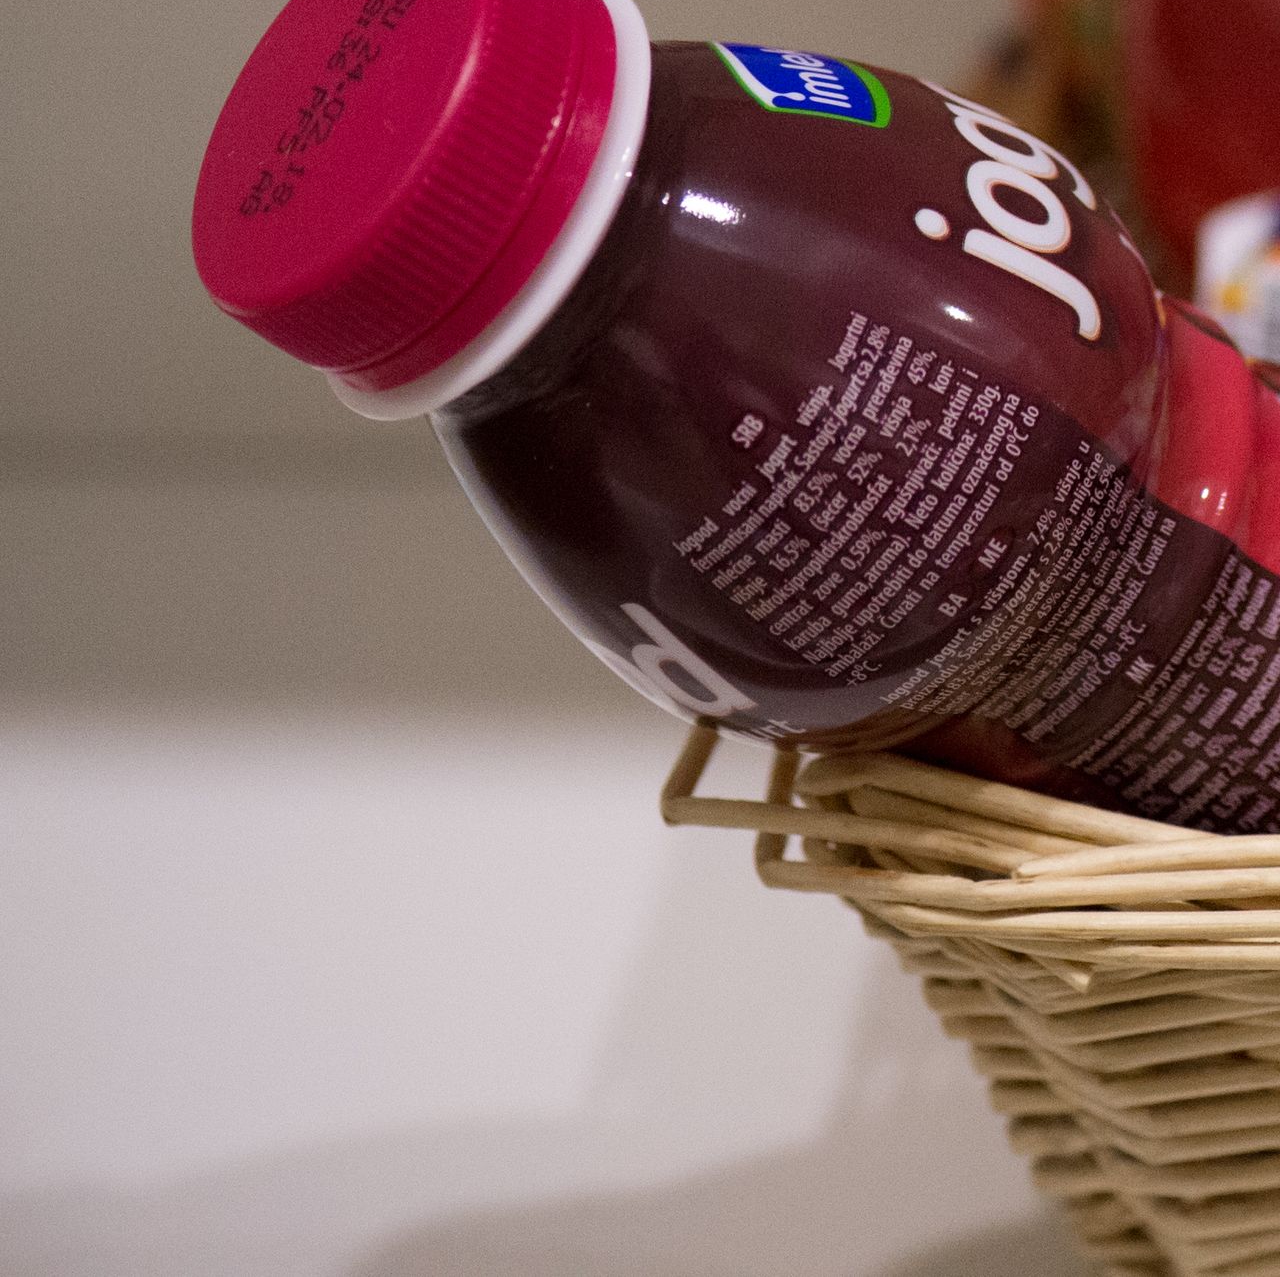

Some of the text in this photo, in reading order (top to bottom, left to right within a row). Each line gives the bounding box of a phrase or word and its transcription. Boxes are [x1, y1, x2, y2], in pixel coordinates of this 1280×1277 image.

[760, 48, 853, 109] imle
[914, 78, 1101, 341] jog
[672, 311, 868, 557] Jogood voćni jogurt višnja. Jogurtni
[690, 325, 891, 573] fermentisani napitak. Sastojci: jogurt sa 2,8%
[732, 414, 764, 448] SRB
[894, 419, 932, 458] 2,1%,
[927, 360, 966, 395] kon-
[711, 553, 756, 590] mlečne
[754, 518, 791, 555] masti
[793, 472, 838, 513] 83,5%,
[832, 423, 867, 465] voćna
[730, 350, 938, 605] višnje 16,5% (šećer 52%, višnja 45%,
[769, 367, 979, 636] centrat zove 0,59%, zgušnjivači: pektini i
[783, 615, 832, 651] karuba
[903, 485, 939, 530] Neto
[930, 428, 978, 491] količina:
[968, 385, 1002, 426] 330g.
[1068, 451, 1105, 516] mliječne
[802, 393, 1021, 665] Najbolje upotrebiti do datuma označenog na
[824, 629, 885, 678] ambalaži.
[879, 588, 923, 629] Čuvati
[919, 570, 941, 591] na
[934, 481, 1001, 569] temperaturi
[995, 456, 1014, 482] od
[1020, 405, 1040, 428] do
[978, 537, 1007, 569] ME
[983, 624, 1020, 657] voćna
[1010, 547, 1078, 626] prerađevina
[1068, 506, 1096, 548] višnje
[1085, 460, 1119, 505] 16,5%
[1039, 554, 1051, 566] s
[1043, 516, 1073, 555] 2,8%
[878, 667, 930, 705] Jogood
[925, 627, 972, 672] jogurt
[970, 615, 988, 627] s
[981, 552, 1032, 611] višnjom.
[1026, 508, 1058, 546] 7,4%
[1053, 459, 1088, 503] višnje
[1078, 440, 1091, 454] u
[937, 593, 968, 618] BA
[1002, 567, 1041, 617] jogurt
[1038, 571, 1098, 640] koncentrat
[1085, 530, 1113, 572] zove
[1054, 580, 1096, 632] karuba
[1085, 549, 1127, 587] guma,
[1089, 632, 1108, 650] na
[1102, 577, 1146, 634] ambalaži.
[1135, 534, 1168, 576] Čuvati
[1159, 517, 1177, 537] na
[956, 612, 1008, 661] Sastojci:
[1002, 618, 1036, 663] višnja
[1030, 580, 1065, 620] 45%,
[1068, 593, 1111, 641] Najbolje
[899, 652, 964, 710] proizvodu.
[1076, 677, 1096, 698] od
[1101, 651, 1122, 669] do
[1125, 656, 1155, 684] MK
